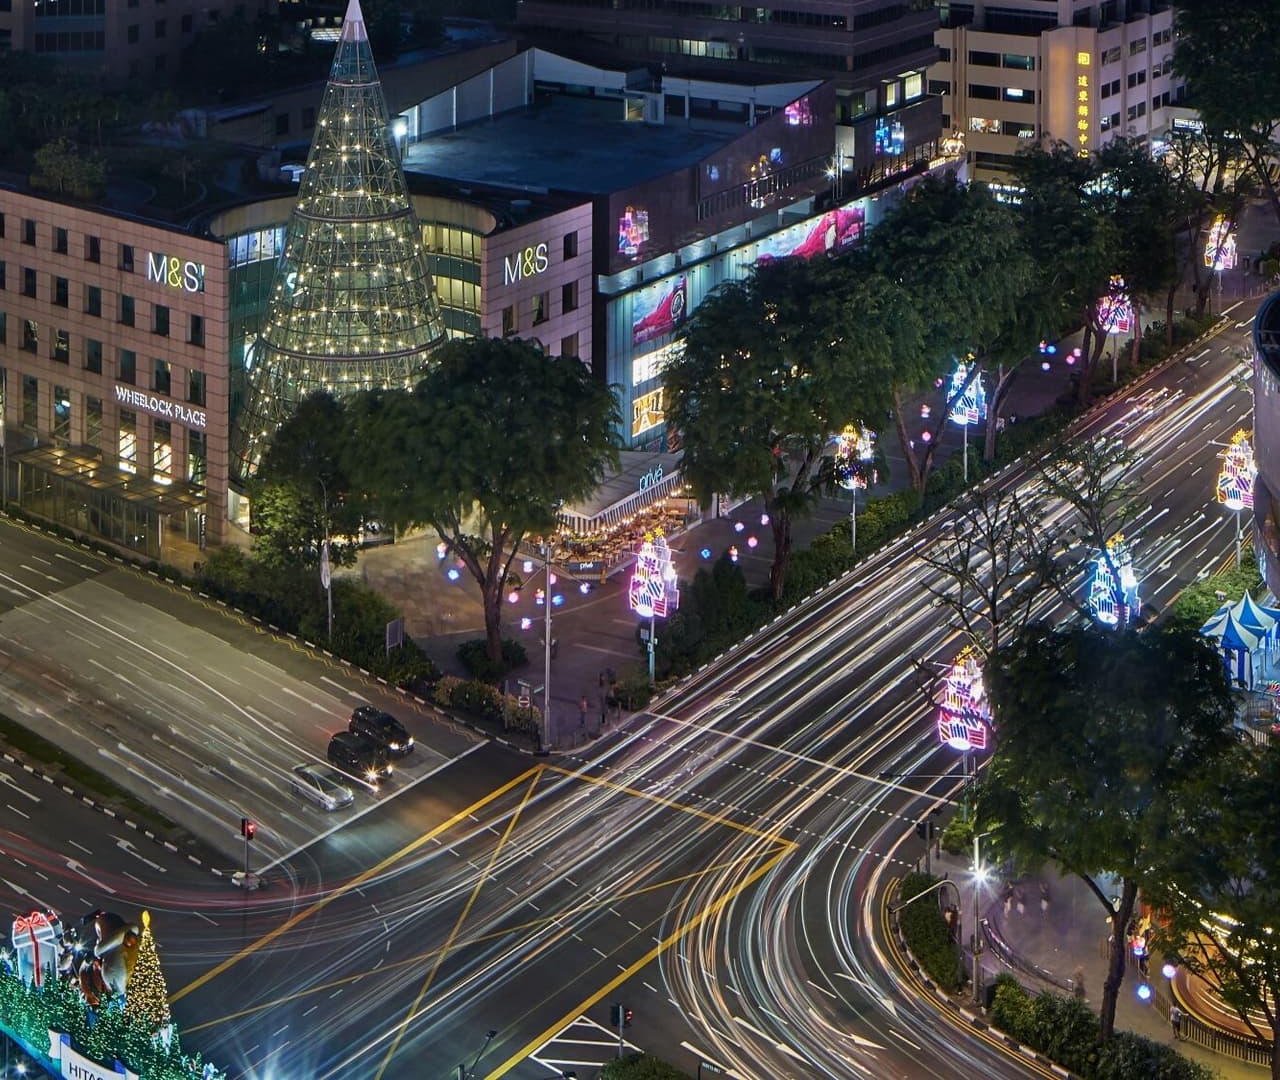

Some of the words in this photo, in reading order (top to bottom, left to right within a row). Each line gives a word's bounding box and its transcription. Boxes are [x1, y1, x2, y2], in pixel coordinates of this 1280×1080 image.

[148, 251, 199, 292] M&S
[504, 243, 548, 286] M&S
[115, 384, 173, 418] WHEELOCK
[174, 404, 207, 428] PLACE
[639, 463, 663, 495] privé
